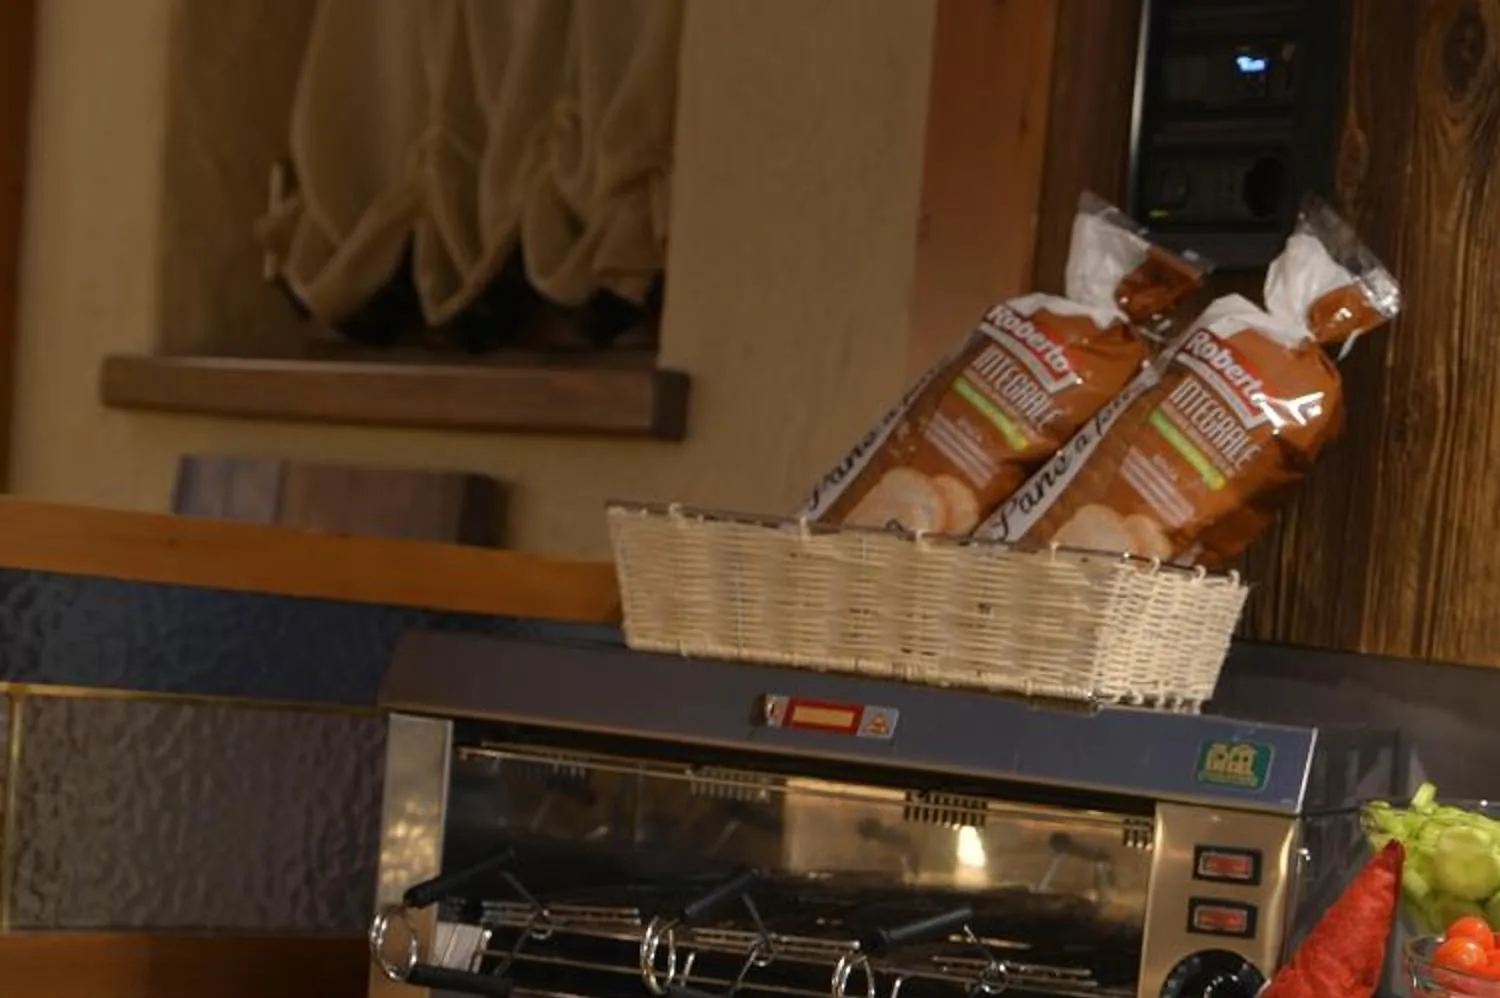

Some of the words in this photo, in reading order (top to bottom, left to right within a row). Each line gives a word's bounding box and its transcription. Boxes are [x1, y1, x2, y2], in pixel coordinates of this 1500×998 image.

[987, 304, 1069, 373] Roberto
[1186, 331, 1266, 405] Roberto
[972, 343, 1064, 433] INTEGRALE
[1169, 376, 1261, 470] INTEGRALE
